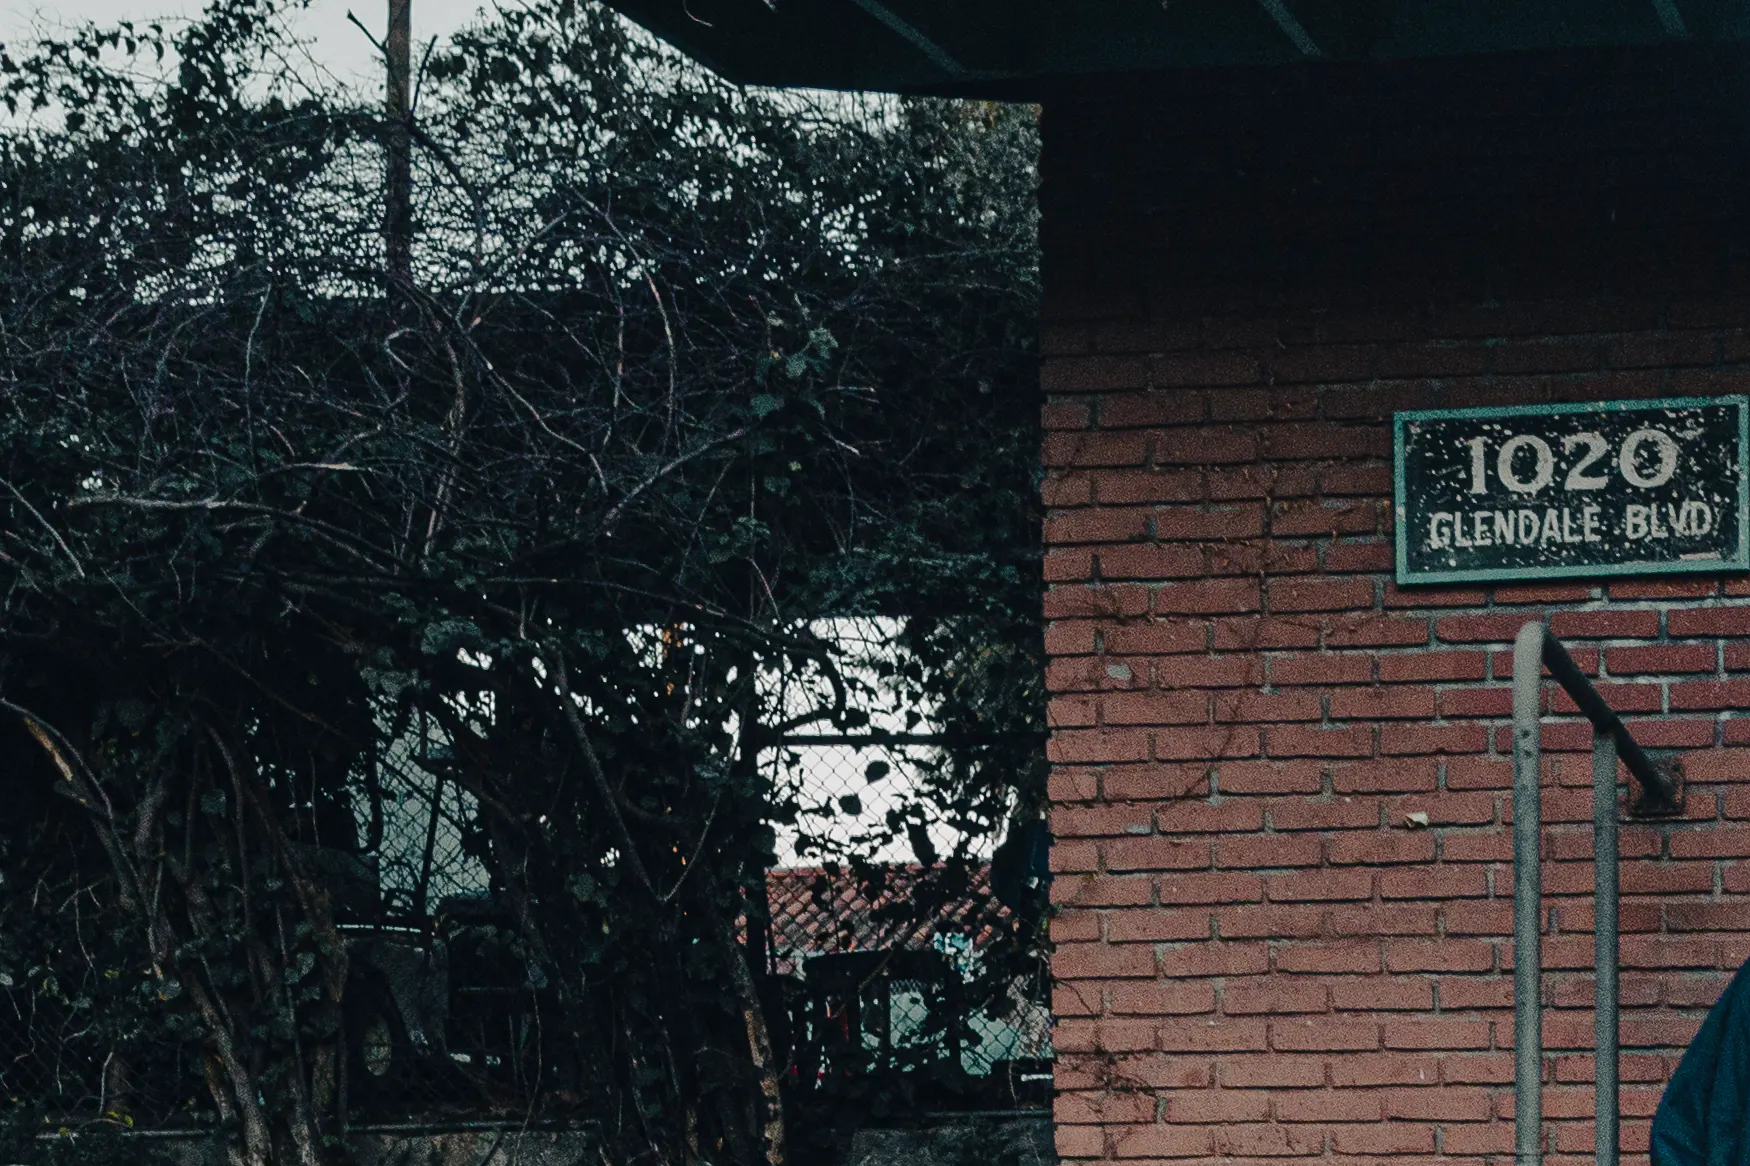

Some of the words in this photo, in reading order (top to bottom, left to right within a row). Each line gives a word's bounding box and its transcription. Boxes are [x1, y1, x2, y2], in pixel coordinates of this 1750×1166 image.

[1467, 427, 1680, 496] 1020
[1429, 503, 1602, 550] GLENDALE
[1624, 497, 1713, 541] BLVD
